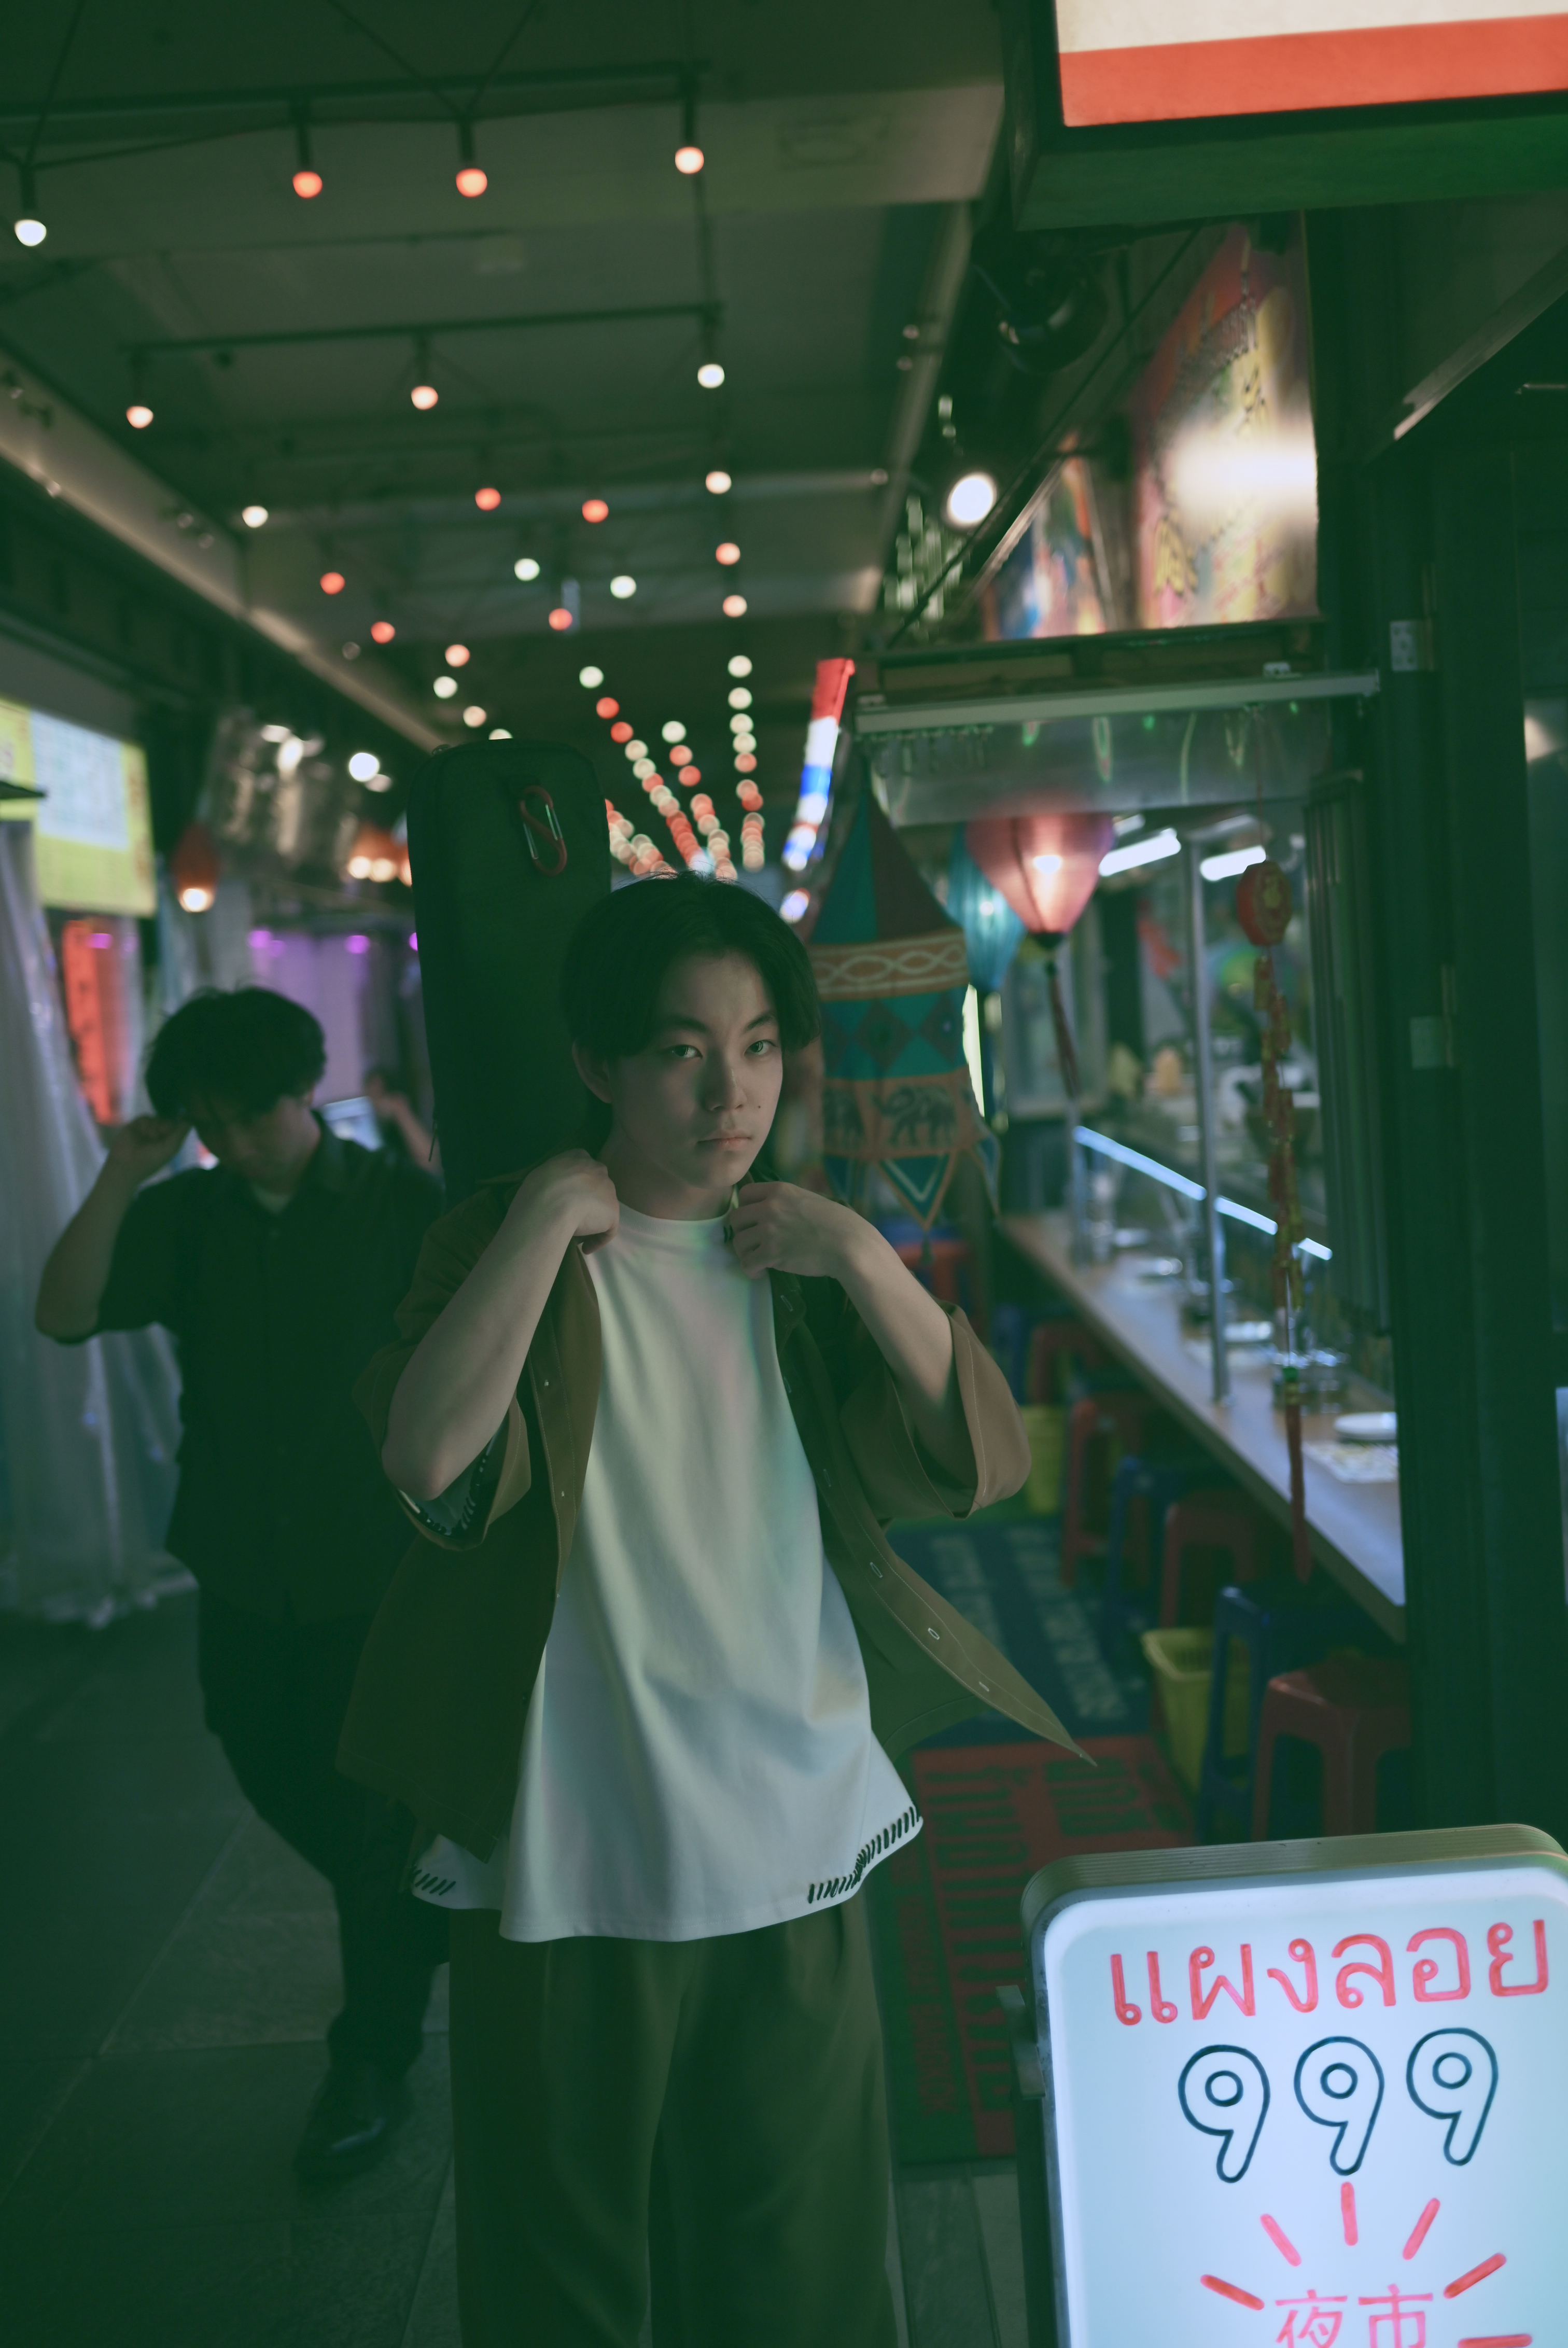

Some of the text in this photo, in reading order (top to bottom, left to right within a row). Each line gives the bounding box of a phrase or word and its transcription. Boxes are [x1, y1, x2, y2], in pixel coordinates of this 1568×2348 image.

[1110, 1919, 1549, 2026] แผงลอย
[1178, 2026, 1499, 2184] 999
[1275, 2283, 1434, 2348] 夜市
